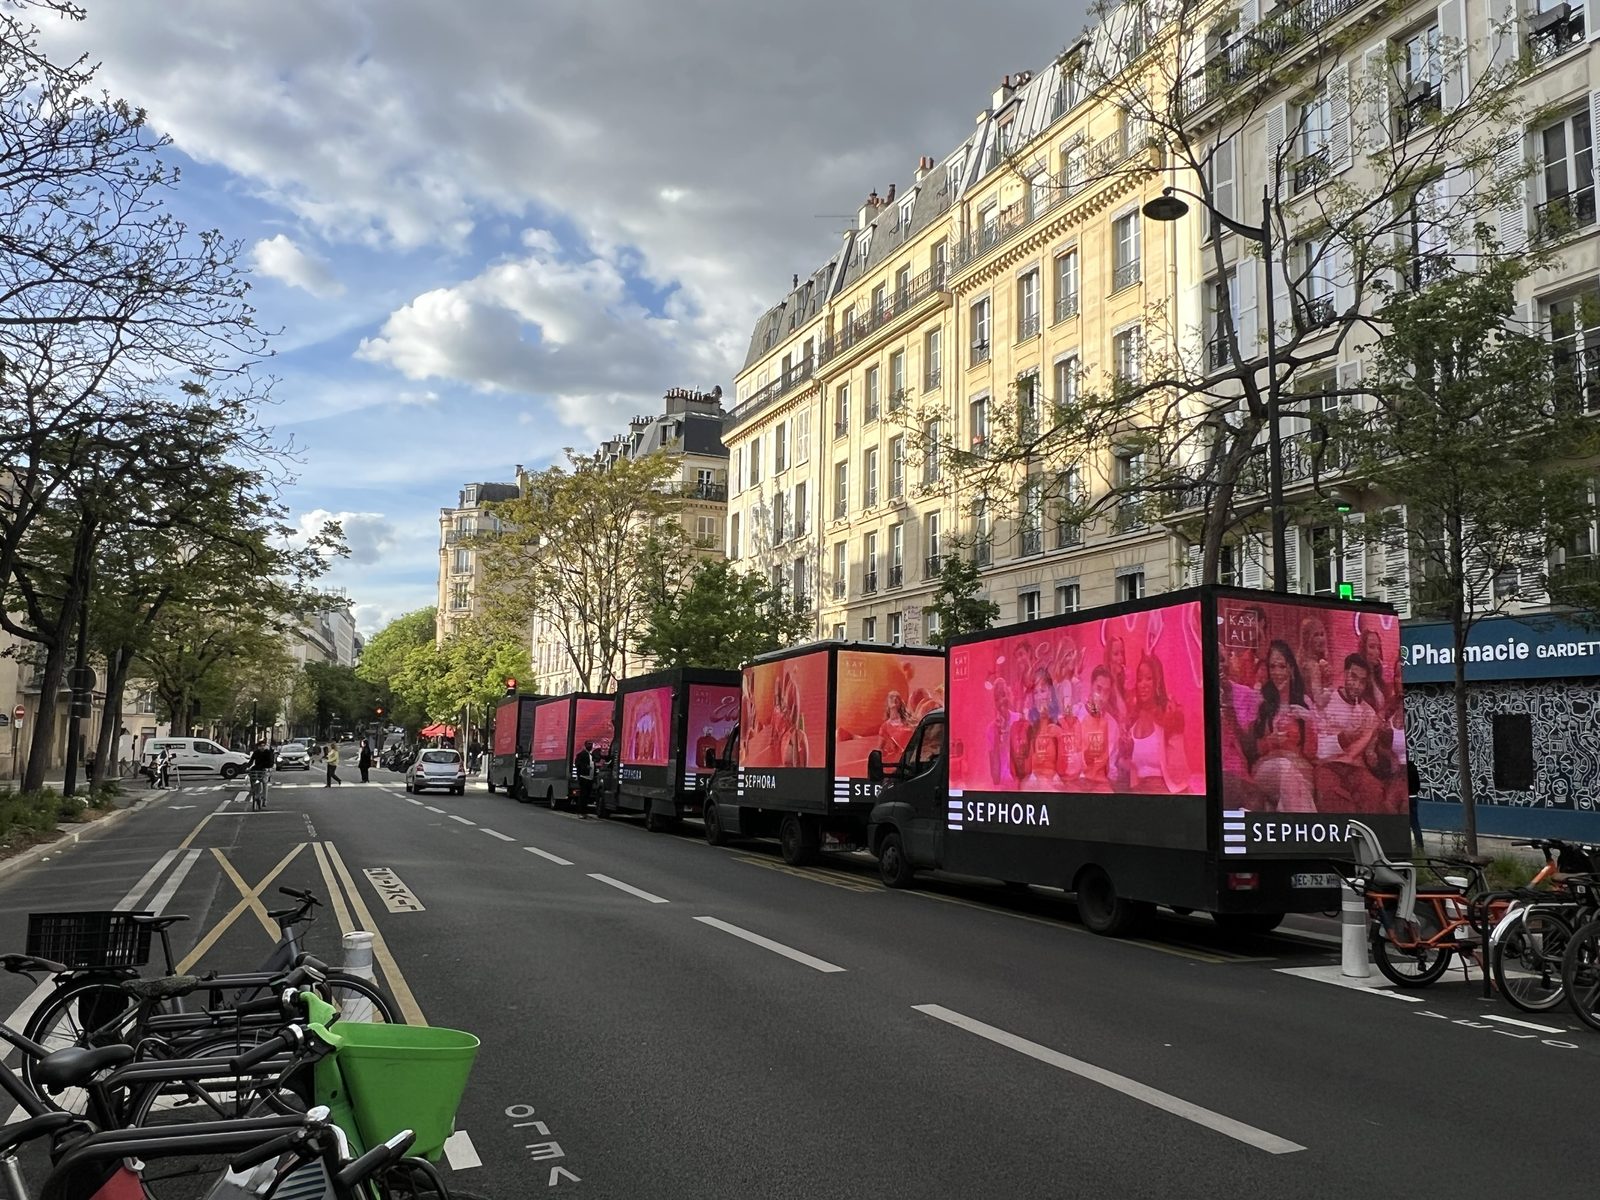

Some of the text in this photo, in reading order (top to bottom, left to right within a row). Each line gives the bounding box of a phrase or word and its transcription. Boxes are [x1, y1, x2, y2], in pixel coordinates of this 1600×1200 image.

[1229, 614, 1255, 627] KAY
[1230, 629, 1254, 642] ALI
[744, 774, 776, 789] SEPHORA
[967, 801, 1050, 826] SEPHORA
